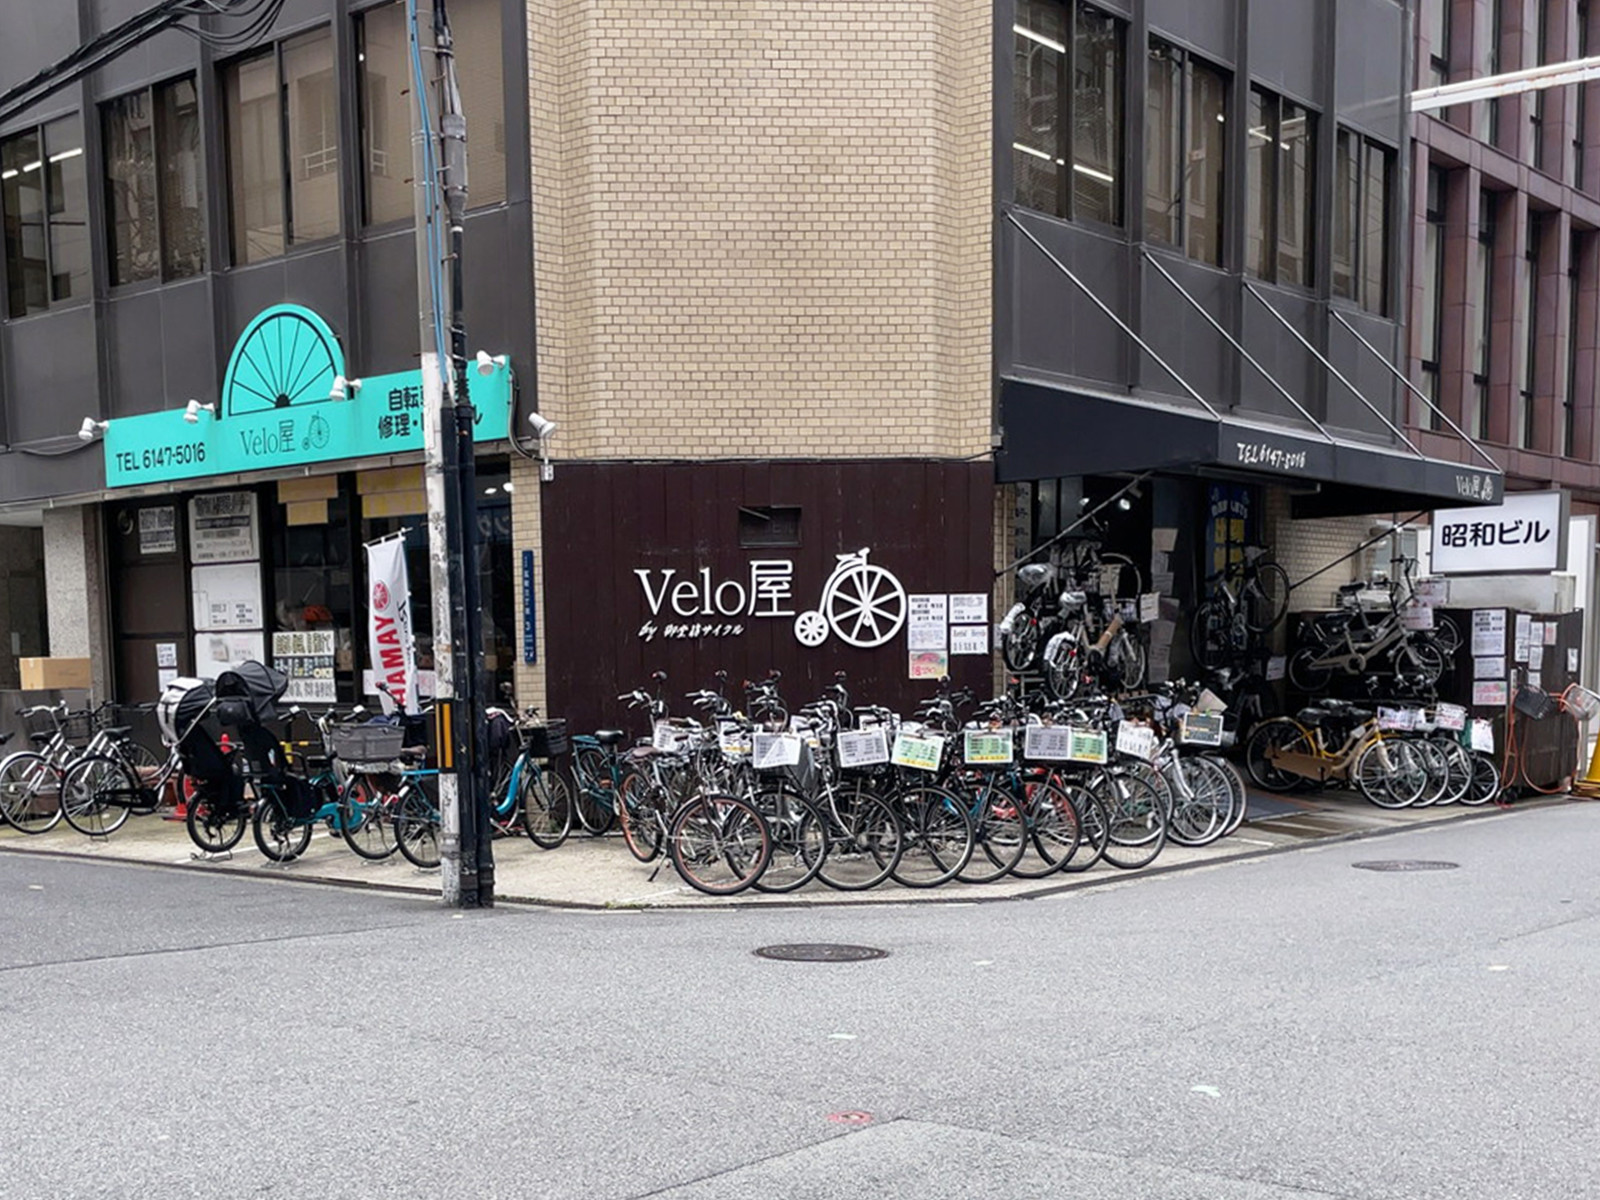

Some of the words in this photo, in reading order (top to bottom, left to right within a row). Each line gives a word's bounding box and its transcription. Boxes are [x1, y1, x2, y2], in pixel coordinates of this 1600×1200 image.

[240, 420, 296, 456] Velo屋
[116, 452, 140, 472] TEL
[142, 442, 206, 469] 6147-5016
[1441, 520, 1551, 547] 昭和ビル
[633, 560, 796, 617] Velo屋
[638, 620, 659, 642] by
